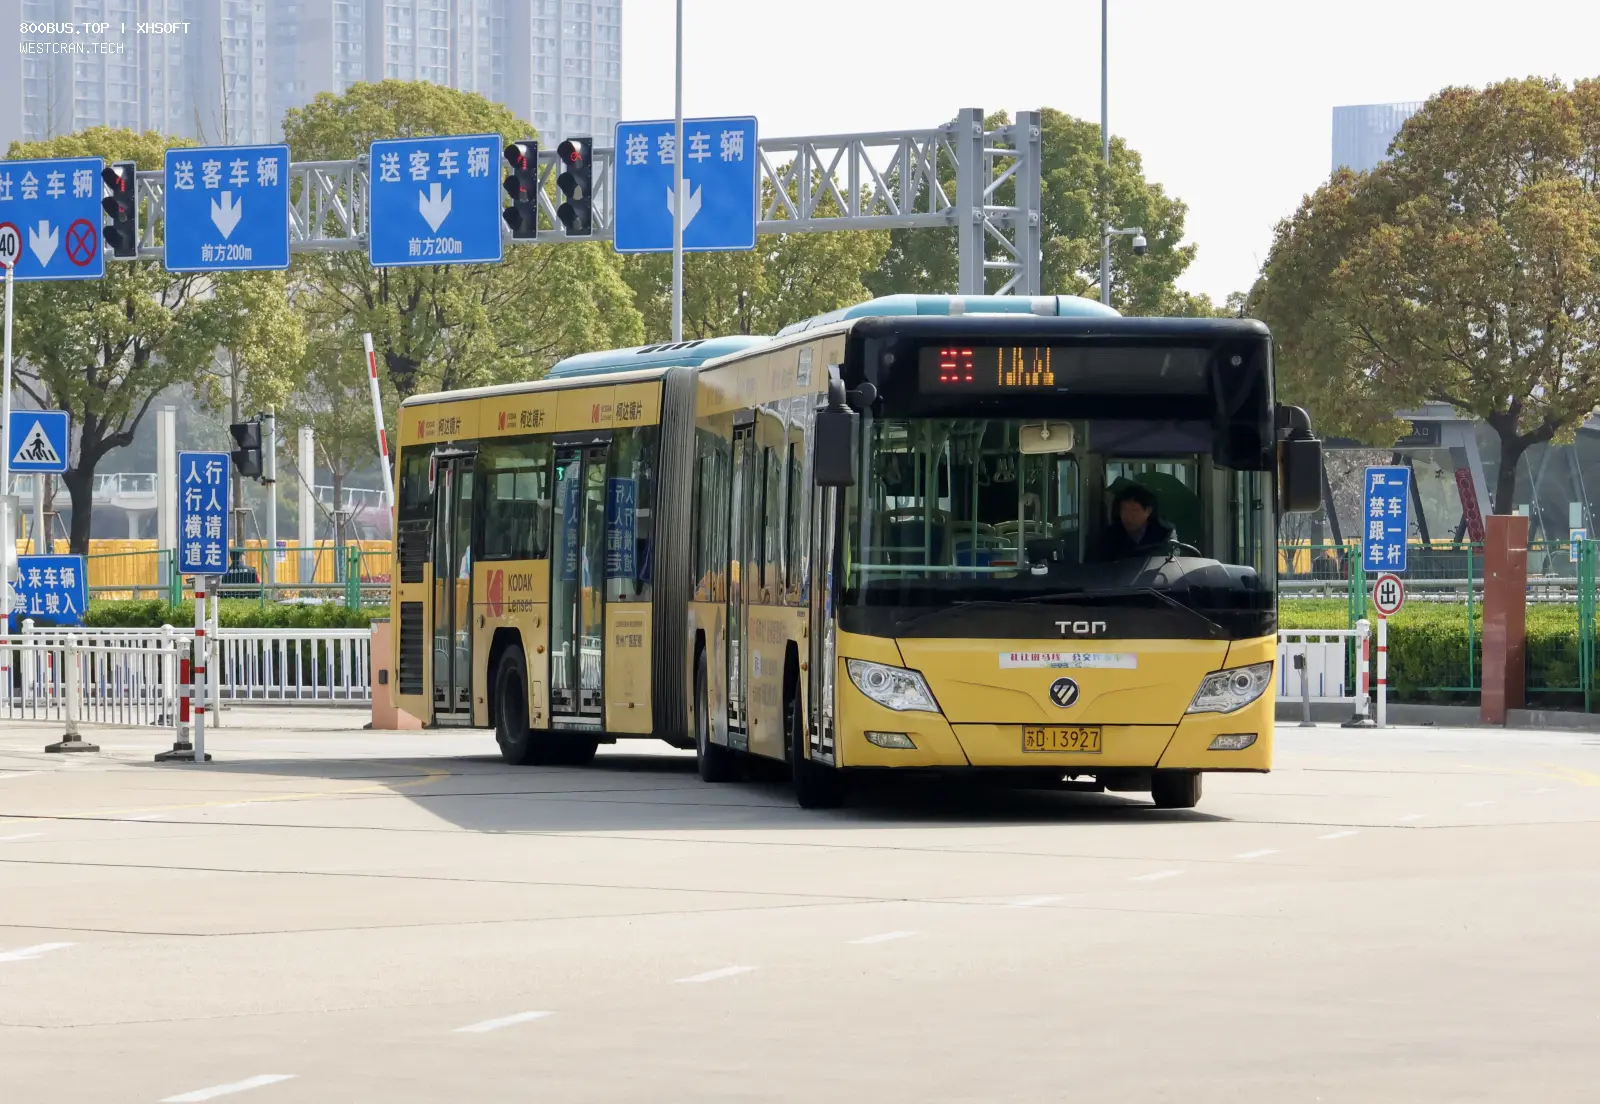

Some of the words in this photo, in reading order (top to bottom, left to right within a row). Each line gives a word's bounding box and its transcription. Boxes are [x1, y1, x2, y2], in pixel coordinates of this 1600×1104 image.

[625, 130, 745, 165] 接客车辆
[174, 156, 278, 190] 送客车辆
[379, 146, 490, 182] 送客车辆
[0, 169, 93, 200] 社会车辆
[0, 232, 15, 256] 40
[201, 243, 252, 262] 前方200m
[409, 237, 463, 256] 前方200m
[185, 460, 203, 566] 人行横道
[205, 460, 223, 566] 行人请走
[1369, 473, 1386, 565] 严禁跟车
[1387, 480, 1403, 565] 一车一杆
[508, 573, 533, 591] KODAK
[1380, 582, 1396, 605] 出
[14, 592, 77, 614] 禁止驶入
[507, 595, 533, 612] Lenses
